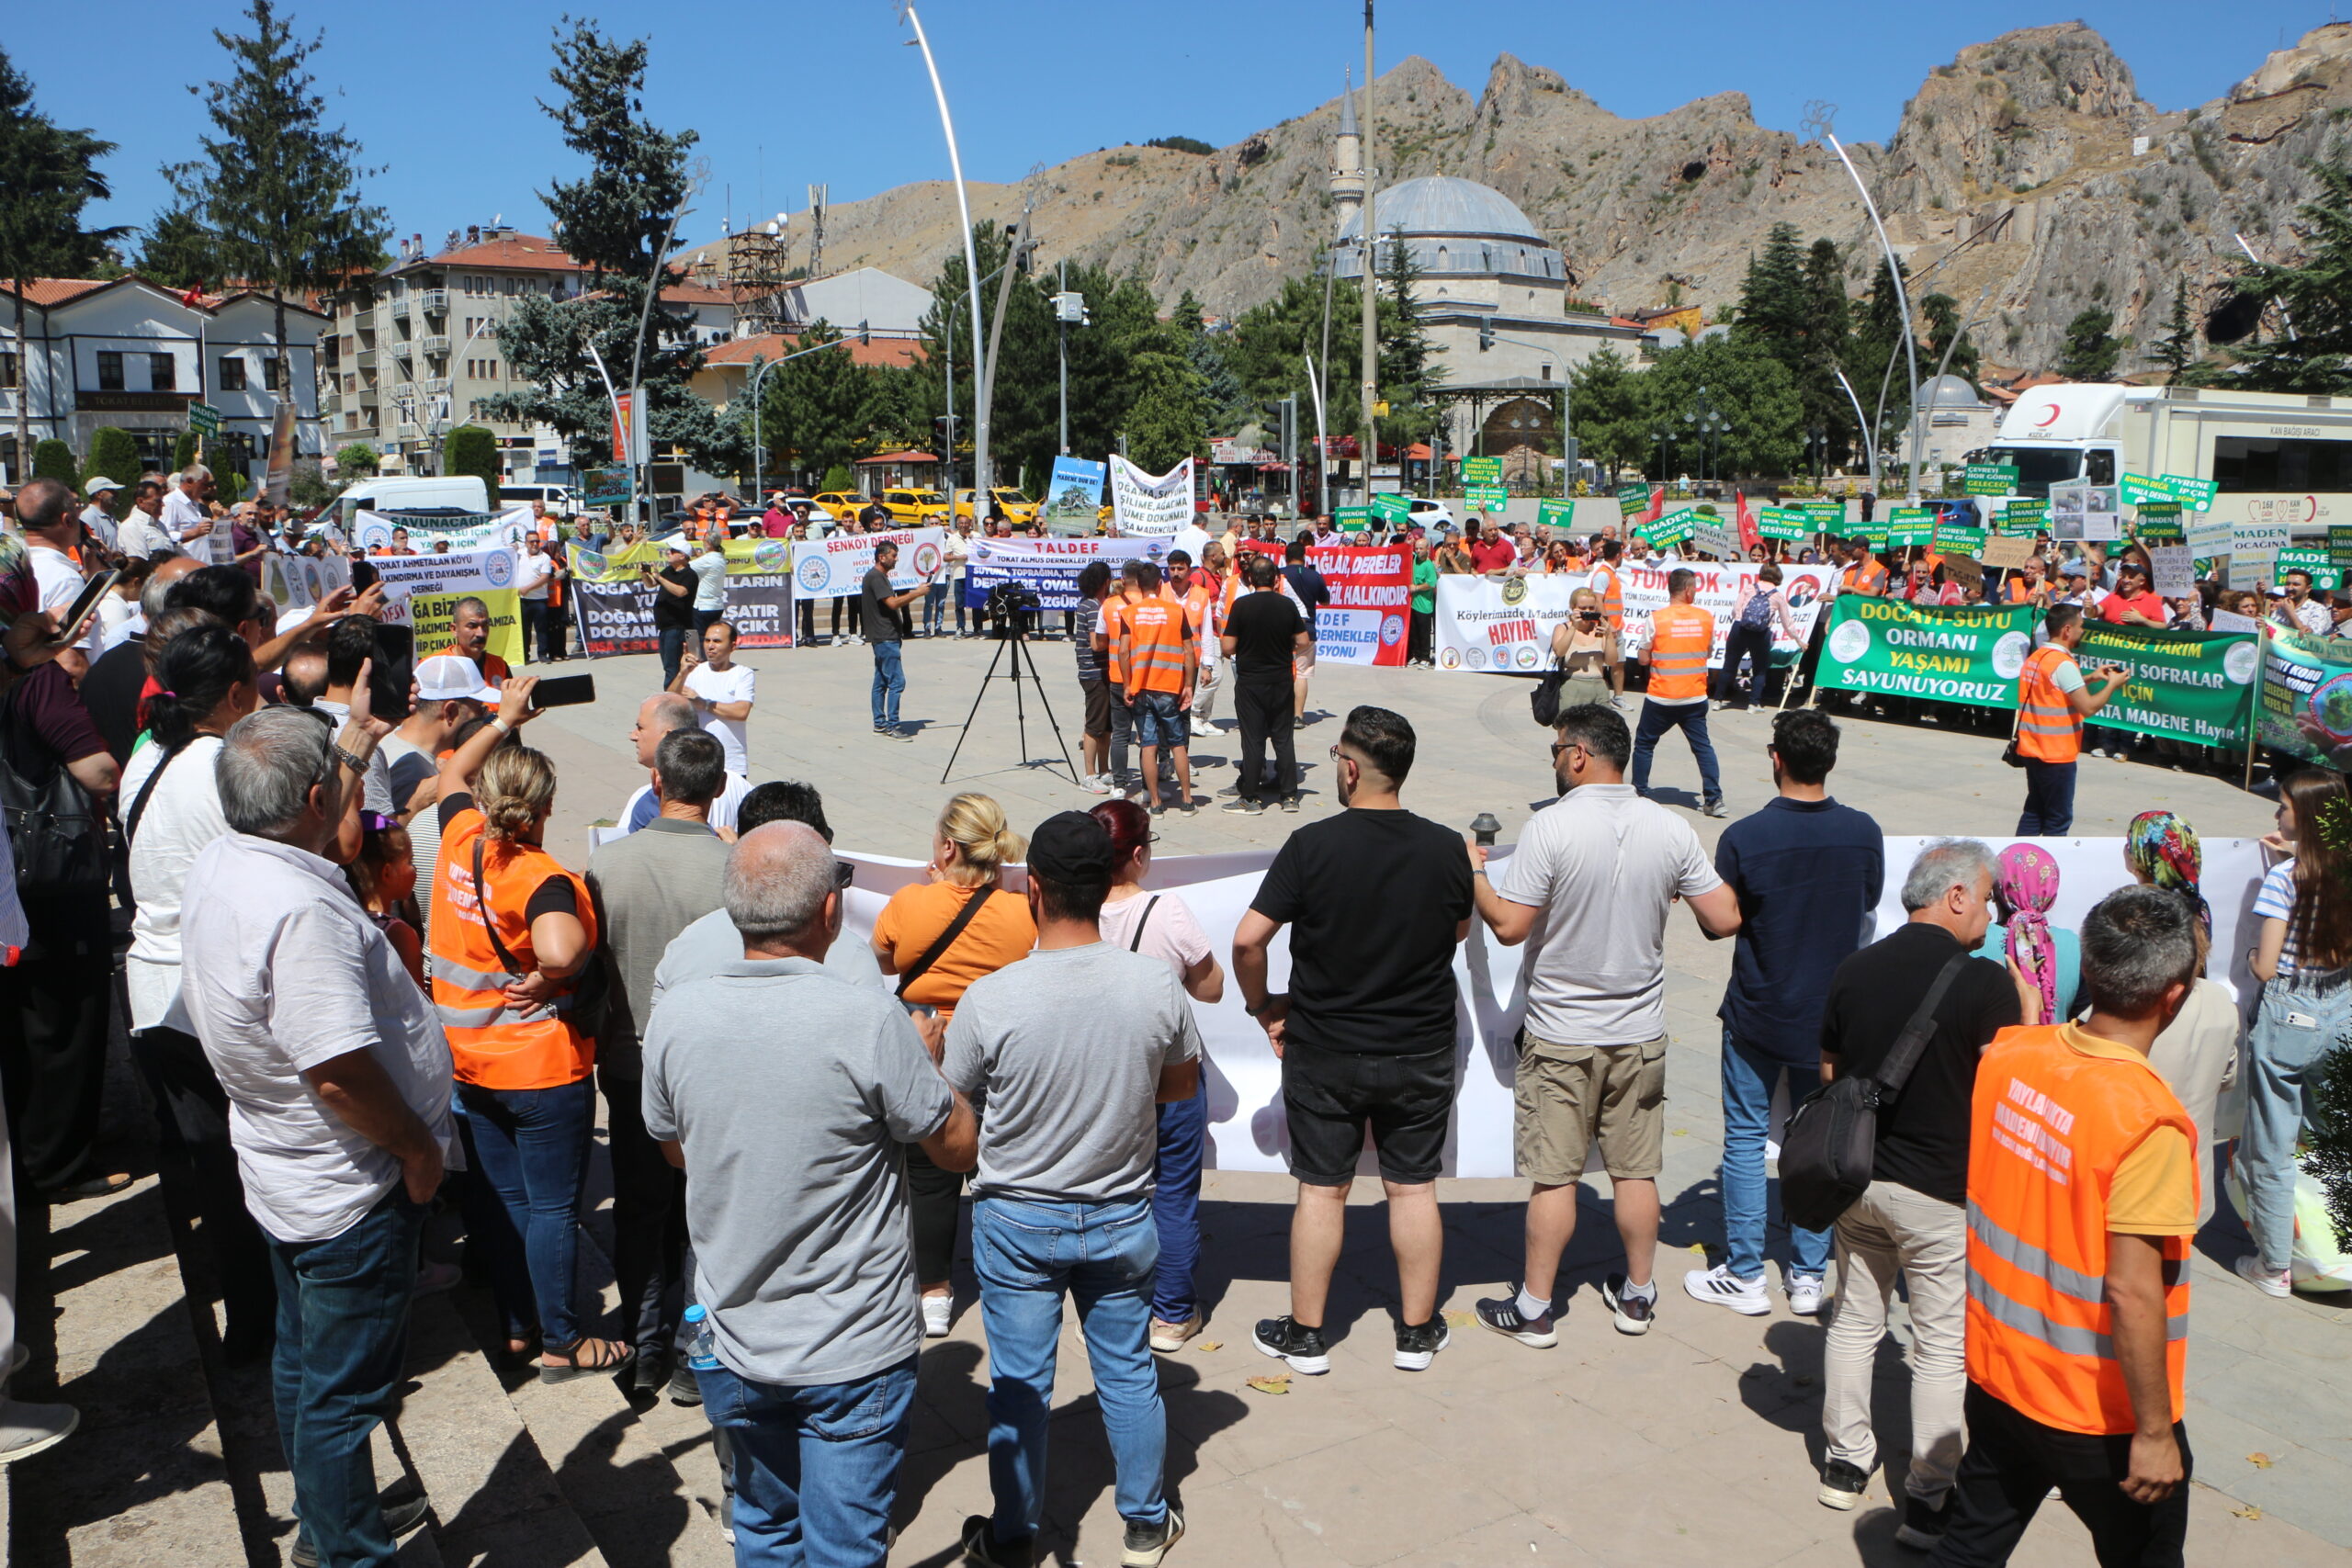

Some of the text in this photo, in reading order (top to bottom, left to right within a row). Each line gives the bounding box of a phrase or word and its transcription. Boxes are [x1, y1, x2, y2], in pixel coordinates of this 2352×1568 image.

[1968, 466, 1998, 474] ÇEVREYİ
[2149, 490, 2175, 502] DESTEK
[1647, 510, 1691, 534] MADEN
[1652, 520, 1693, 541] OCAĞINA
[1696, 526, 1729, 541] MADEN
[1759, 525, 1793, 536] SESİYİZ
[1938, 526, 1967, 535] ÇEVREYİ
[2233, 528, 2288, 540] MADEN
[826, 534, 868, 556] ŞENKÖY
[1656, 533, 1681, 548] HAYIR
[1954, 535, 1981, 543] GÖREN
[2234, 540, 2288, 549] OCAĞINA
[1034, 542, 1101, 554] TALDEF
[402, 557, 450, 570] AHMETALAN
[451, 554, 472, 565] KÖYÜ
[997, 556, 1019, 564] TOKAT
[1021, 556, 1045, 564] ALMUS
[1046, 556, 1088, 564] DERNEKLER
[1351, 553, 1402, 575] DERELER
[2279, 552, 2330, 564] MADE
[424, 570, 435, 580] VE
[435, 567, 481, 580] DAYANIŞMA
[973, 566, 1011, 578] SUYUNA,
[1012, 567, 1063, 580] TOPRAĞINA,
[1630, 564, 1671, 591] TÜM
[412, 581, 444, 594] DERNEĞİ
[582, 581, 633, 595] DOĞA
[1343, 585, 1409, 606] HALKINDIR
[1624, 592, 1638, 600] TÜM
[1703, 598, 1713, 606] VE
[587, 608, 639, 625] DOĞA
[1456, 607, 1572, 624] Köylerimizde Madene
[1860, 601, 2013, 630] DOĞAYI-SUYU
[736, 621, 770, 634] ÇIK
[1487, 619, 1539, 646] HAYIR!
[1885, 627, 1978, 651] ORMANI
[2080, 628, 2204, 660] ZEHİRSİZ TARIM
[1889, 650, 1972, 675] YAŞAMI
[2139, 663, 2225, 690] SOFRALAR
[2289, 664, 2324, 683] KORU
[1840, 668, 2007, 703] SAVUNUYORUZ
[2120, 681, 2154, 704] İÇİN
[2285, 676, 2317, 695] KORU
[2125, 707, 2190, 733] MADENE
